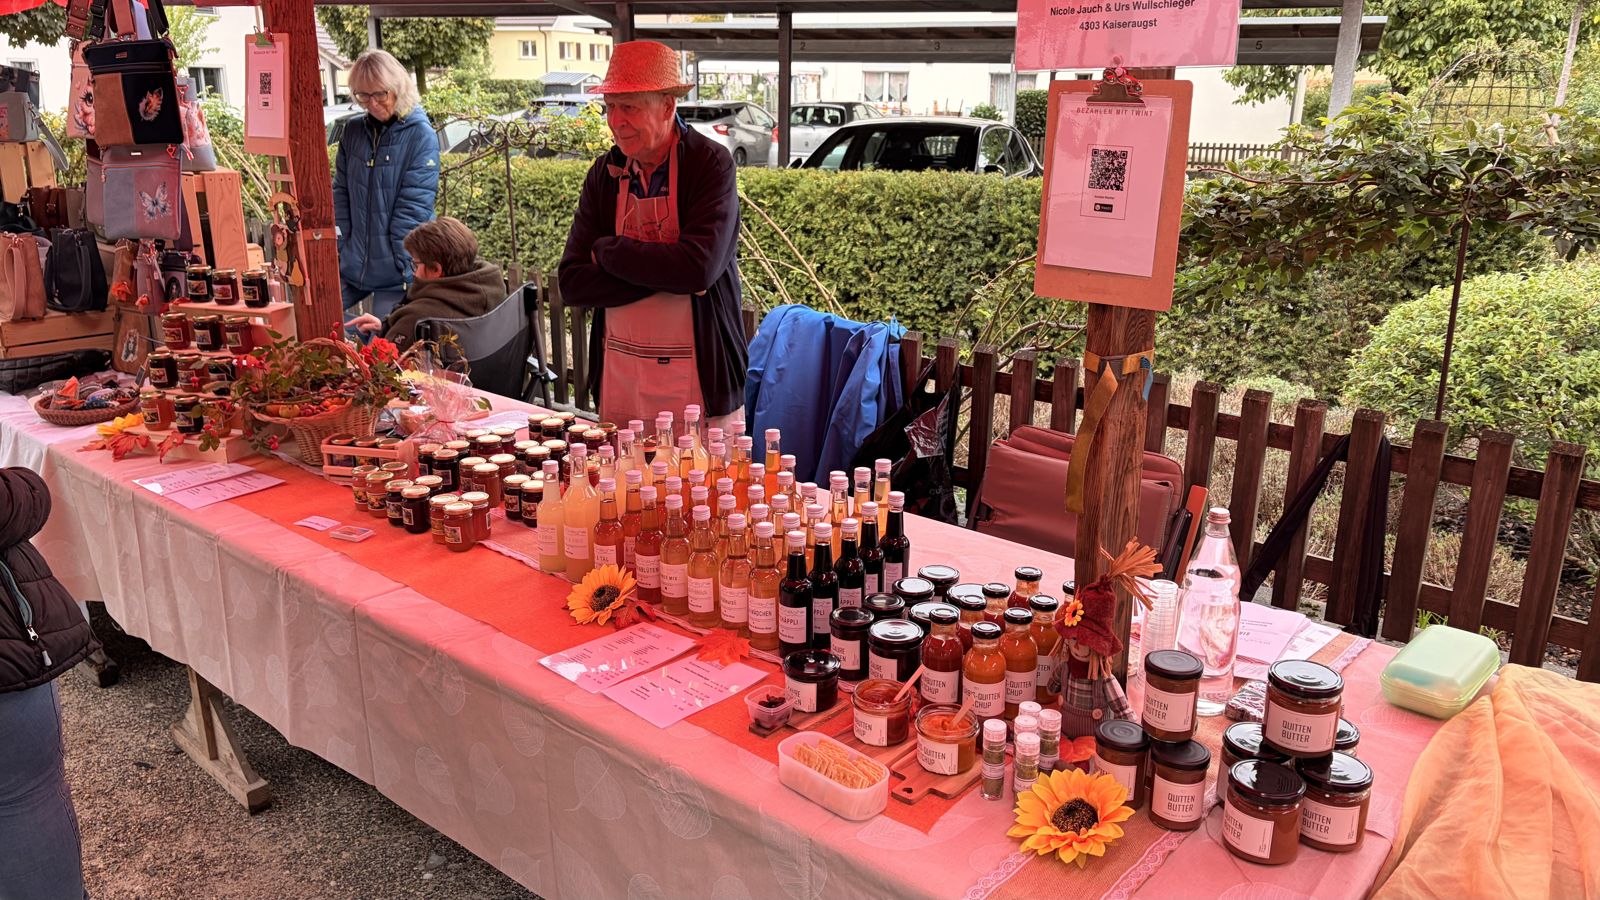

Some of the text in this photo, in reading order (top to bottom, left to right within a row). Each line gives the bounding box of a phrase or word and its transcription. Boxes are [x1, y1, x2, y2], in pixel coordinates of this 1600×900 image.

[1050, 6, 1075, 16] Nicole
[1077, 4, 1103, 14] Jauch
[1105, 2, 1112, 12] &
[1114, 2, 1130, 12] Urs
[1079, 18, 1158, 31] 4303 Kaiseraugst
[800, 41, 806, 50] 2
[934, 41, 941, 51] 3
[1255, 40, 1263, 50] 5
[1145, 703, 1167, 720] BUTTER
[1282, 720, 1312, 734] QUITTEN
[1281, 729, 1310, 743] BUTTER
[1167, 792, 1196, 804] QUITTEN
[1167, 802, 1194, 813] BUTTER
[1303, 807, 1332, 825] QUITTEN
[1302, 817, 1330, 834] BUTTER
